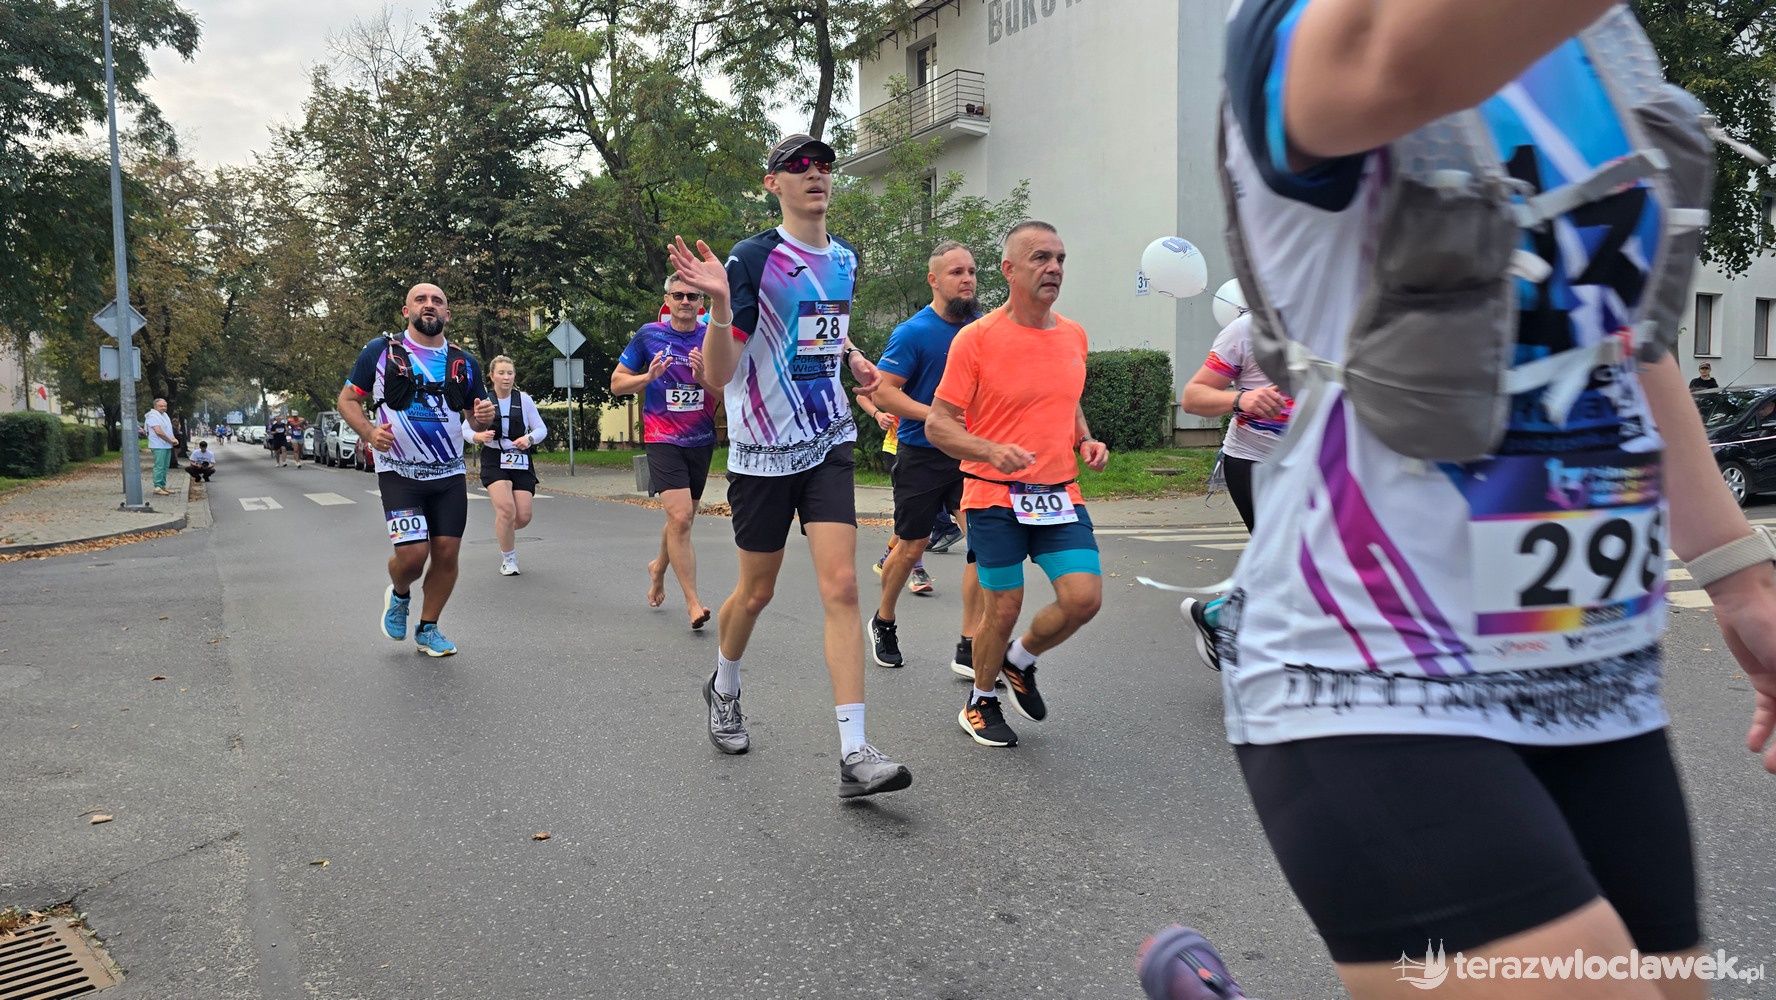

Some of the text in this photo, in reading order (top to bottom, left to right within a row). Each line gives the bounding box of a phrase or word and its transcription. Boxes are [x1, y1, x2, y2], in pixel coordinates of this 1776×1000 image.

[987, 0, 1084, 45] Buko
[816, 316, 840, 339] 28
[671, 390, 700, 403] 522
[505, 453, 524, 465] 271
[1020, 494, 1063, 513] 640
[391, 517, 421, 533] 400
